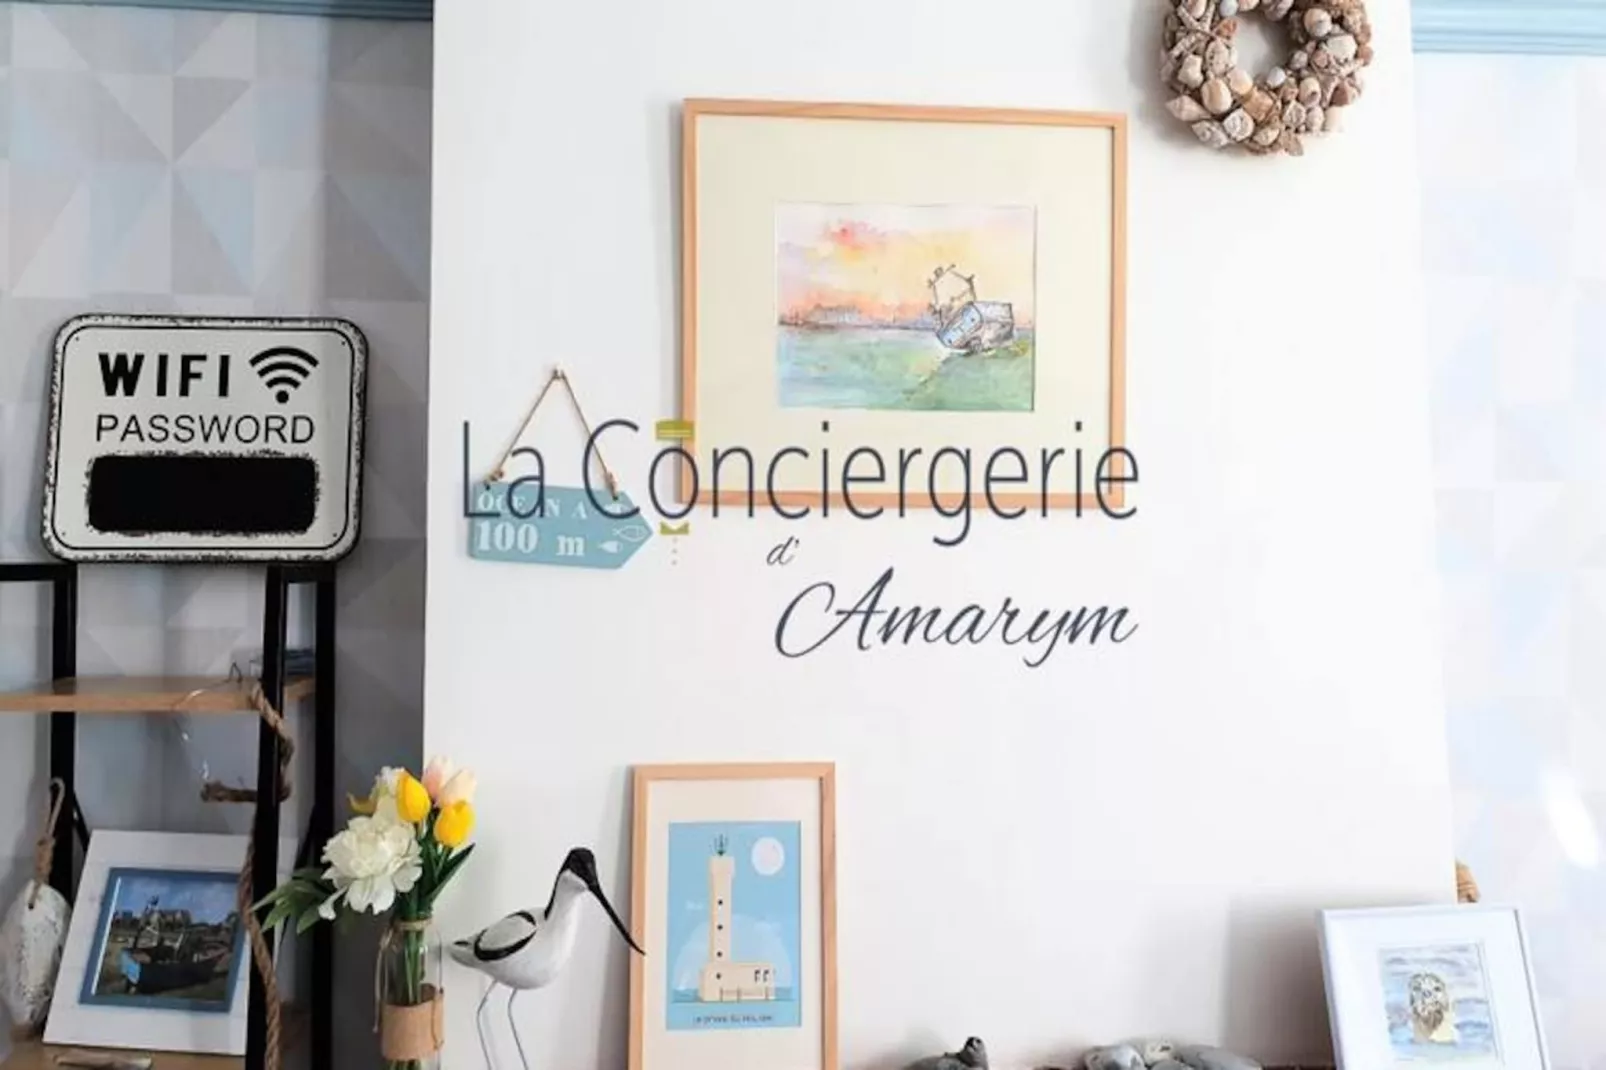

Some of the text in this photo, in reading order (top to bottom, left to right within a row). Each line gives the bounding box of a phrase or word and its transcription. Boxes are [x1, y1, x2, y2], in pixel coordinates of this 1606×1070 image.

[98, 352, 231, 397] WIFI
[96, 414, 315, 443] PASSWORD
[477, 520, 586, 557] 100 m
